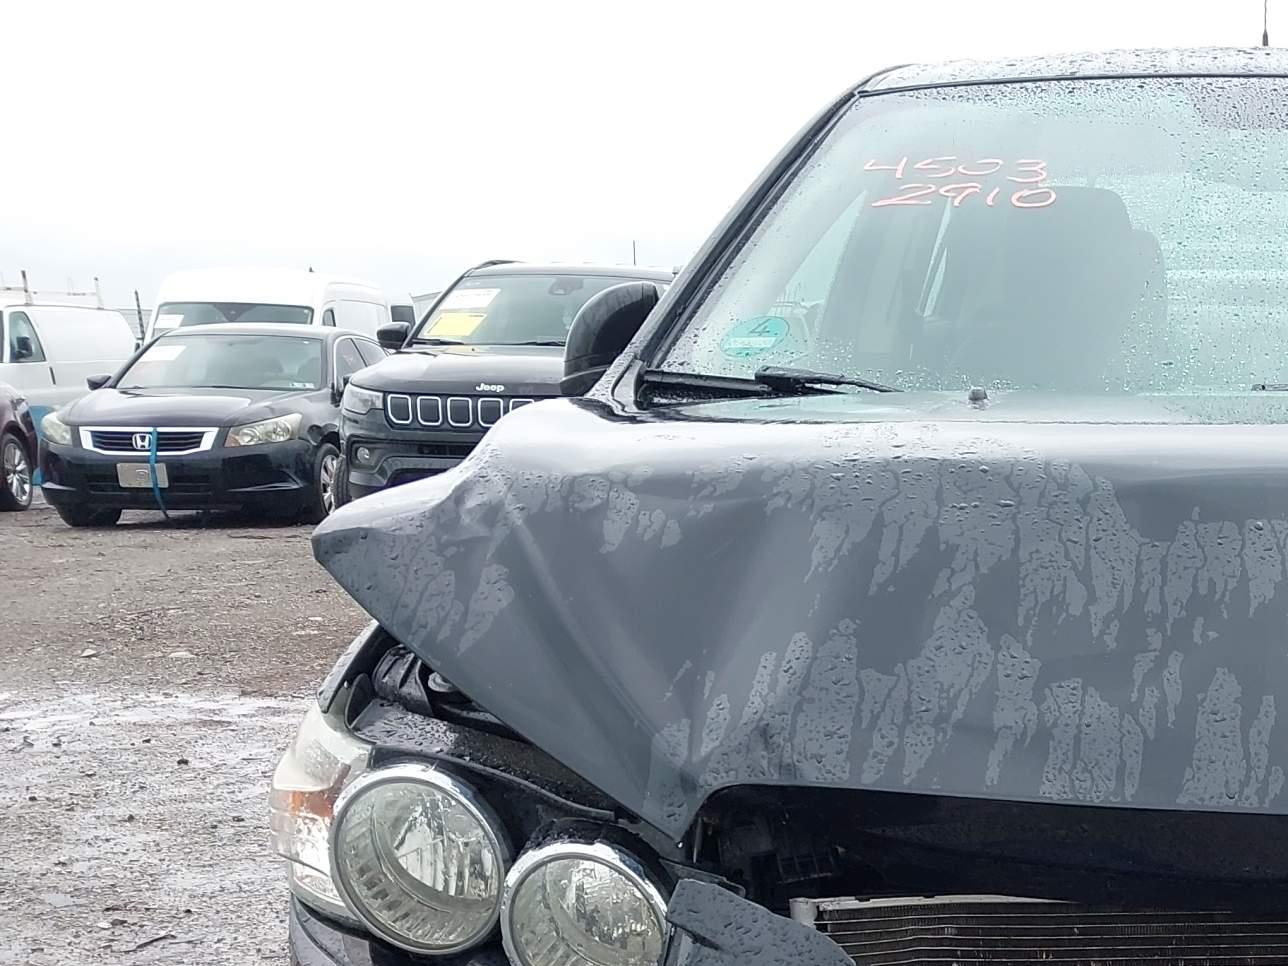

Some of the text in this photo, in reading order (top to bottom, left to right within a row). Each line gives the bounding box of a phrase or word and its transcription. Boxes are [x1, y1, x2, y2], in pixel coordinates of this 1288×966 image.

[863, 156, 1048, 183] 4503
[871, 182, 1057, 208] 2910
[475, 382, 505, 393] Jeep
